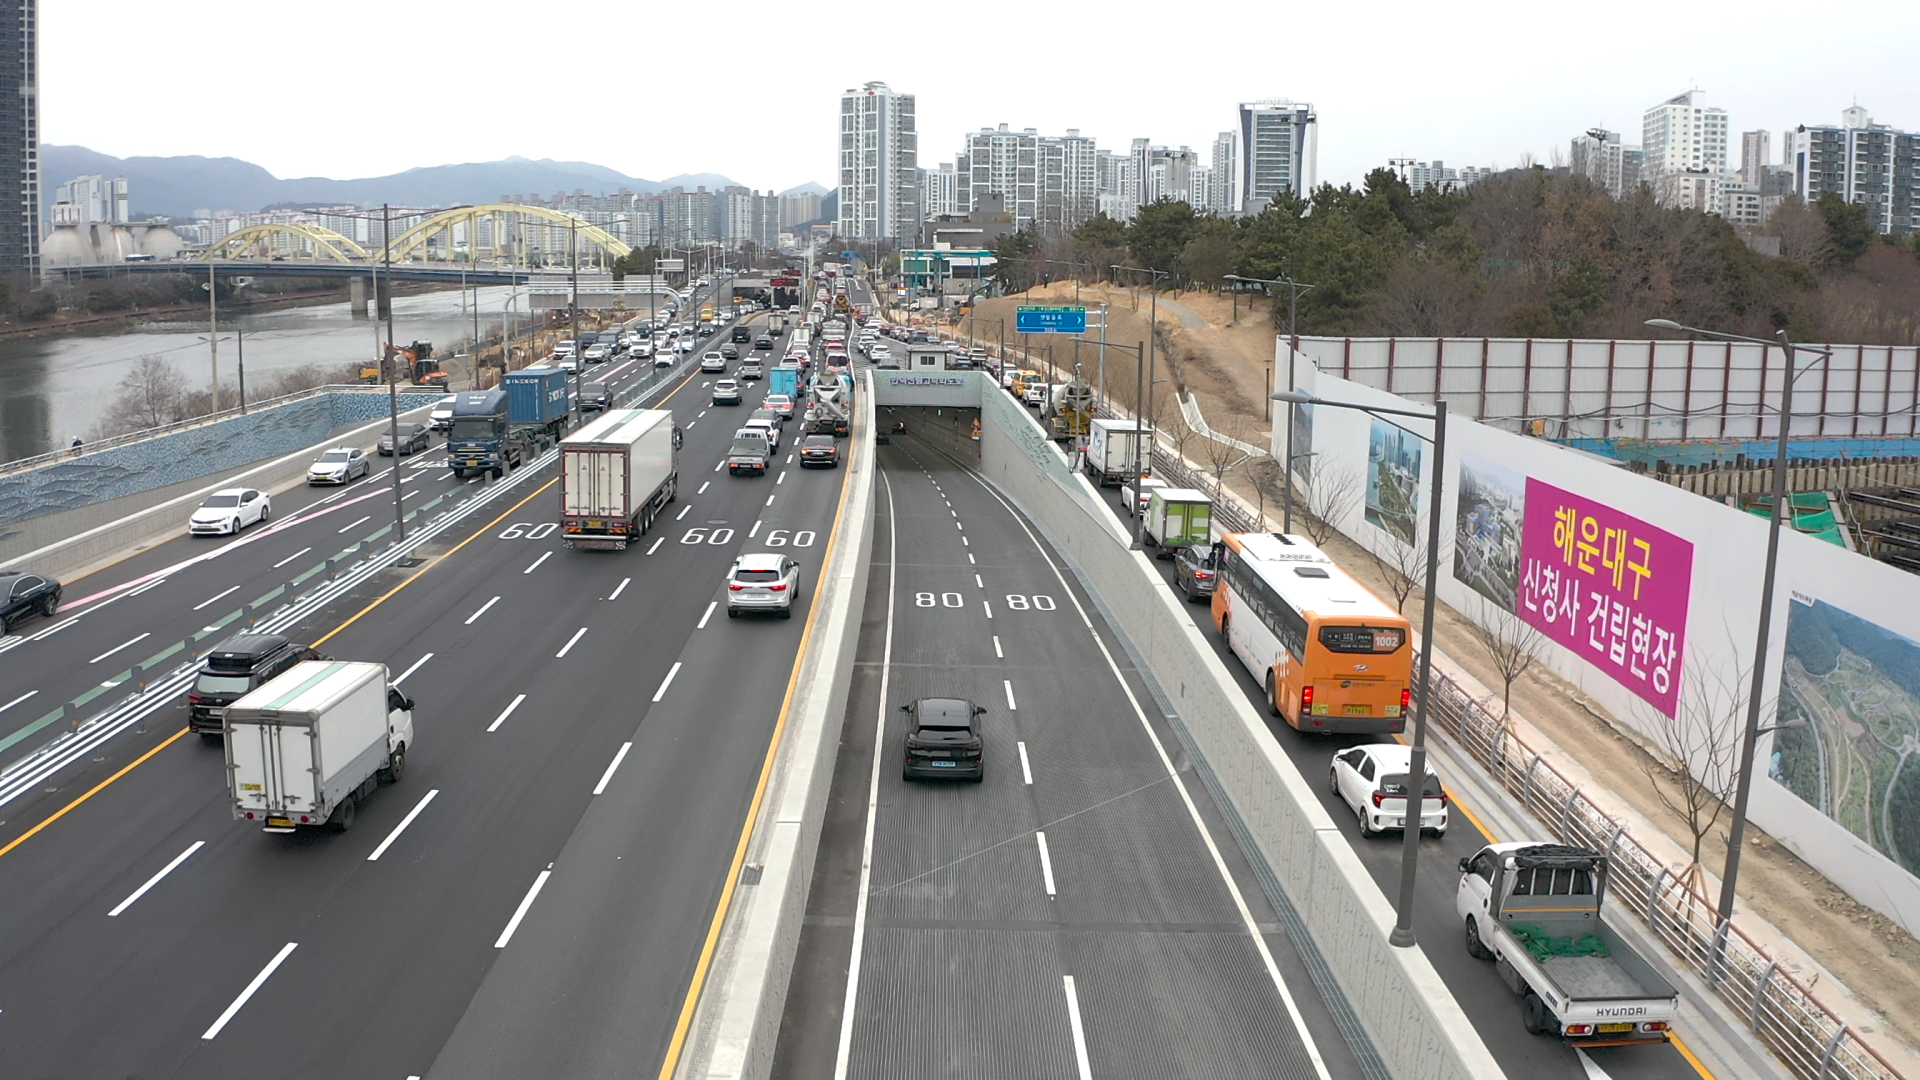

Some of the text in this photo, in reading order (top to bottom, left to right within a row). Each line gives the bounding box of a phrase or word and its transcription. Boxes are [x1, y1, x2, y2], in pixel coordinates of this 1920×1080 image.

[498, 522, 560, 540] 60
[680, 527, 735, 546] 60
[765, 529, 816, 548] 60
[1553, 504, 1652, 601] 해운대구
[915, 592, 964, 608] 80
[1006, 594, 1057, 611] 80
[1523, 557, 1677, 695] 신청사 건립현장
[1375, 636, 1398, 647] 1002
[1596, 1007, 1647, 1017] HYUNDAI
